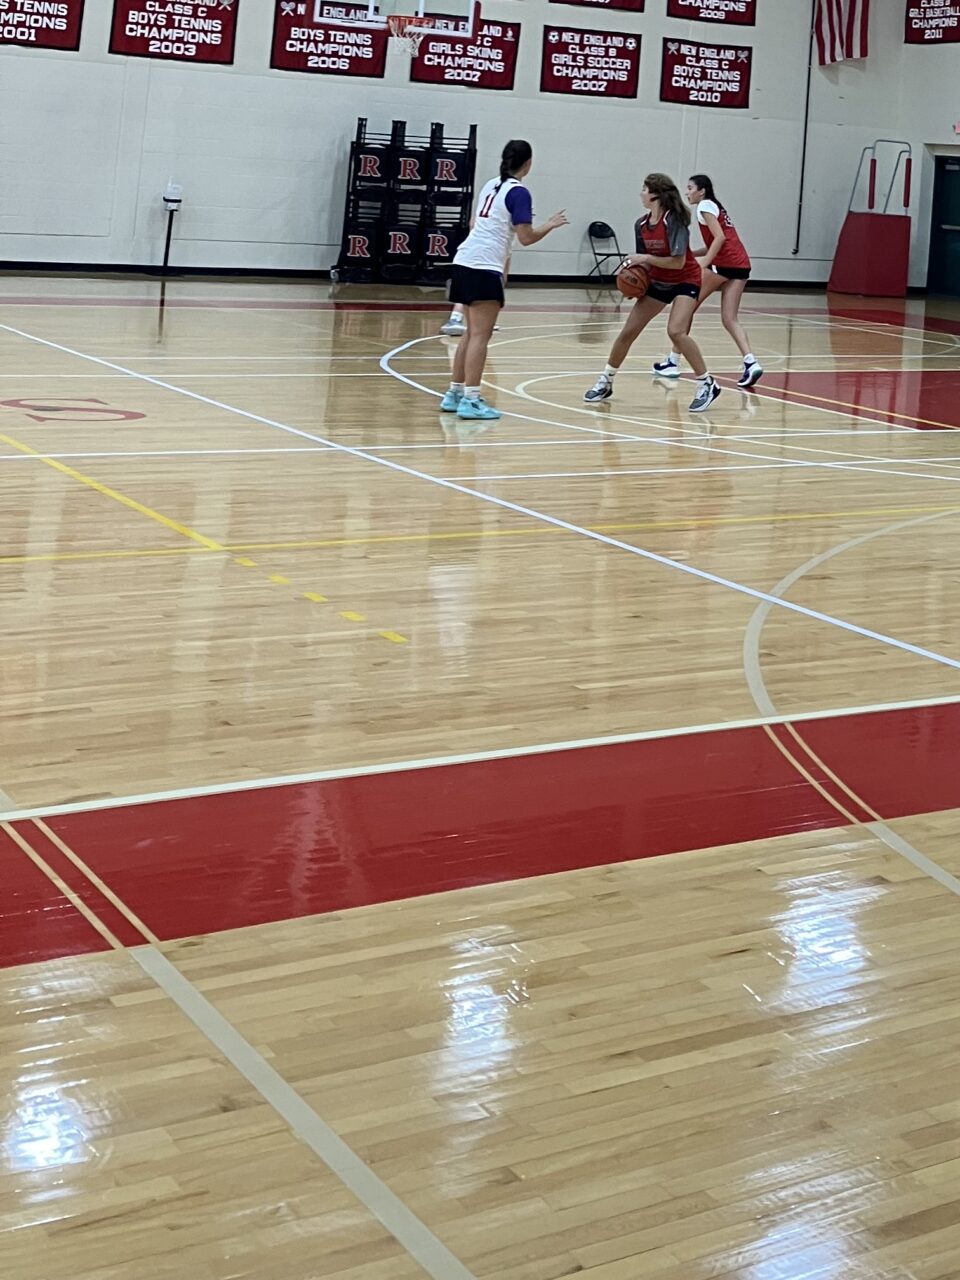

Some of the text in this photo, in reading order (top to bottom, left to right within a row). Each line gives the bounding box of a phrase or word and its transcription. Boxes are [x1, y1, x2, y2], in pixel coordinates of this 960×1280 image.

[145, 0, 207, 17] CLASS C
[128, 10, 222, 31] BOYS TENNIS
[125, 23, 222, 44] CHAMPIONS
[290, 26, 372, 45] BOYS TENNIS
[561, 31, 624, 47] NEW ENGLAND
[148, 40, 196, 56] 2003
[285, 39, 373, 58] CHAMPIONS
[568, 44, 616, 56] CLASS B
[679, 43, 735, 60] NEW ENGLAND
[307, 55, 349, 69] 2006
[551, 53, 631, 70] GIRLS SOCCER
[685, 56, 729, 69] CLASS C
[552, 65, 628, 81] CHAMPIONS
[673, 64, 740, 81] BOYS TENNIS
[571, 79, 607, 91] 2007
[671, 76, 740, 92] CHAMPIONS
[688, 89, 721, 102] 2010
[358, 155, 381, 177] R
[398, 158, 421, 180] R
[434, 159, 457, 181] R
[347, 235, 370, 257] R
[388, 232, 411, 254] R
[426, 234, 449, 256] R
